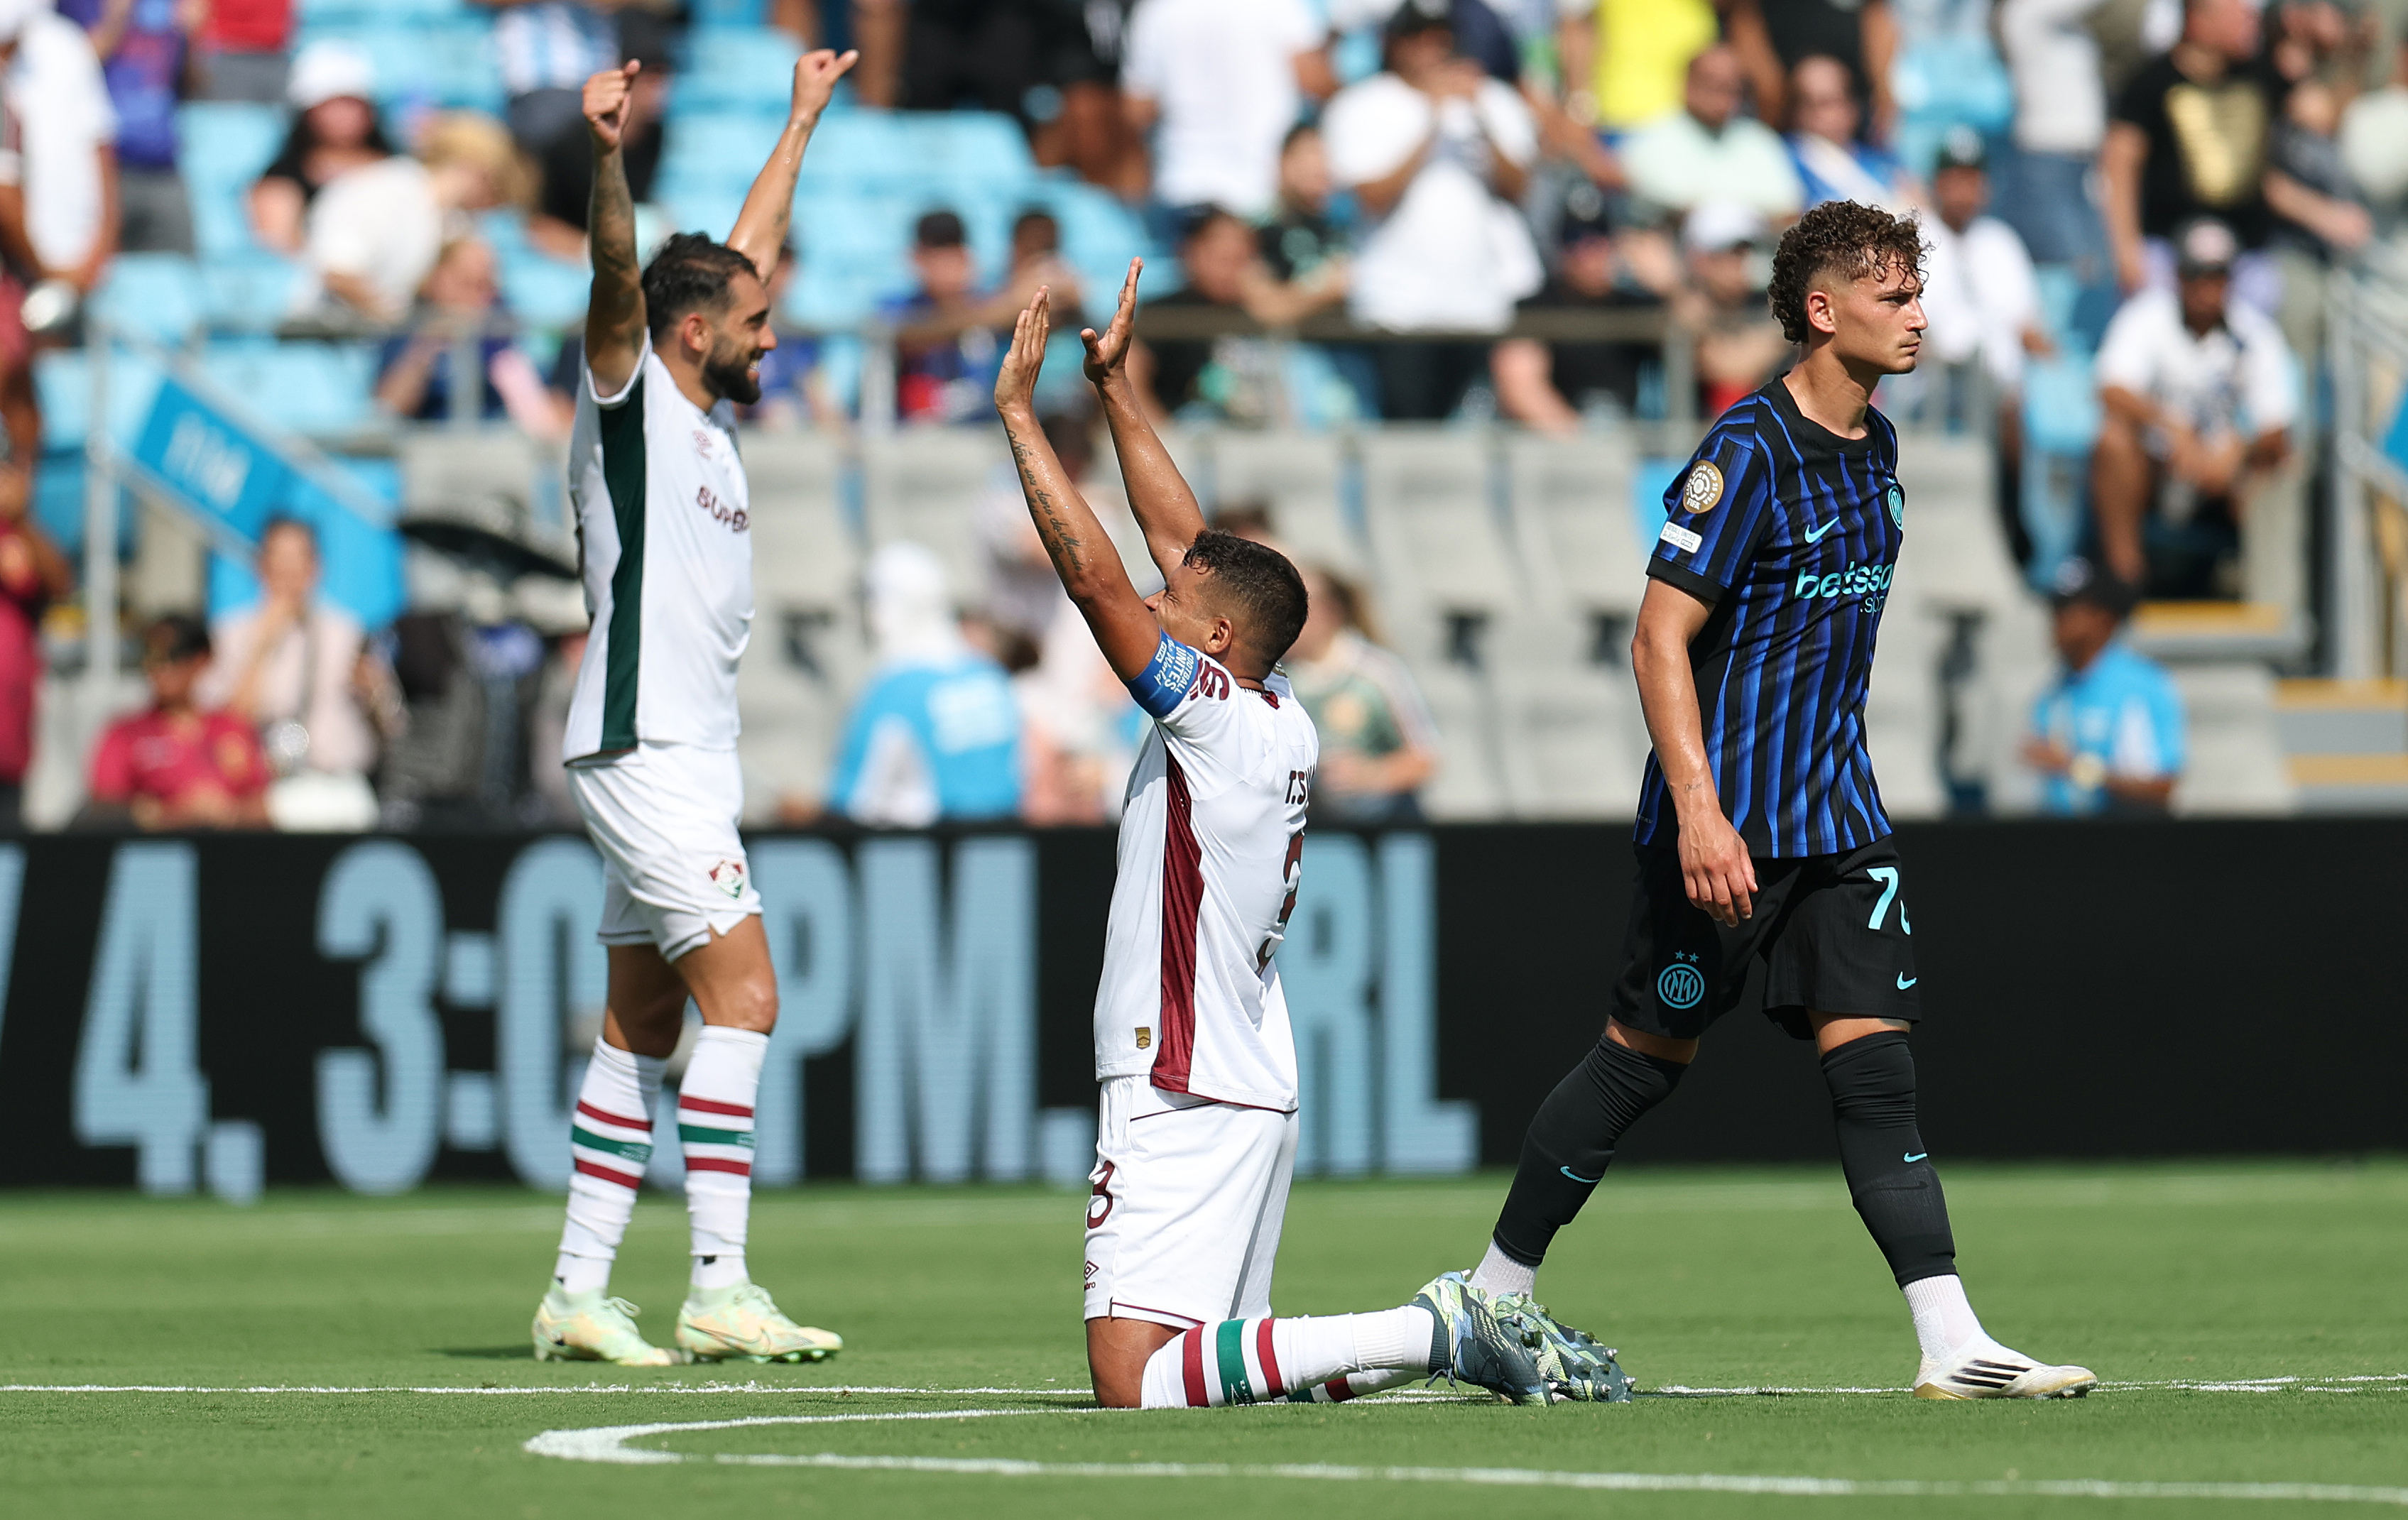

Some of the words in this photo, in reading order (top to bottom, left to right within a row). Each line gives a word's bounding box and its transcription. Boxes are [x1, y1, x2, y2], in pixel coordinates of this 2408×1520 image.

[1707, 469, 1717, 481] CUP
[1687, 498, 1701, 510] FIFA
[1703, 493, 1716, 505] USA
[1794, 561, 1894, 600] betsso
[1154, 652, 1175, 686] World
[1165, 646, 1187, 690] UNITES
[1173, 650, 1194, 694] FOOTBALL
[1087, 1160, 1116, 1229] 3
